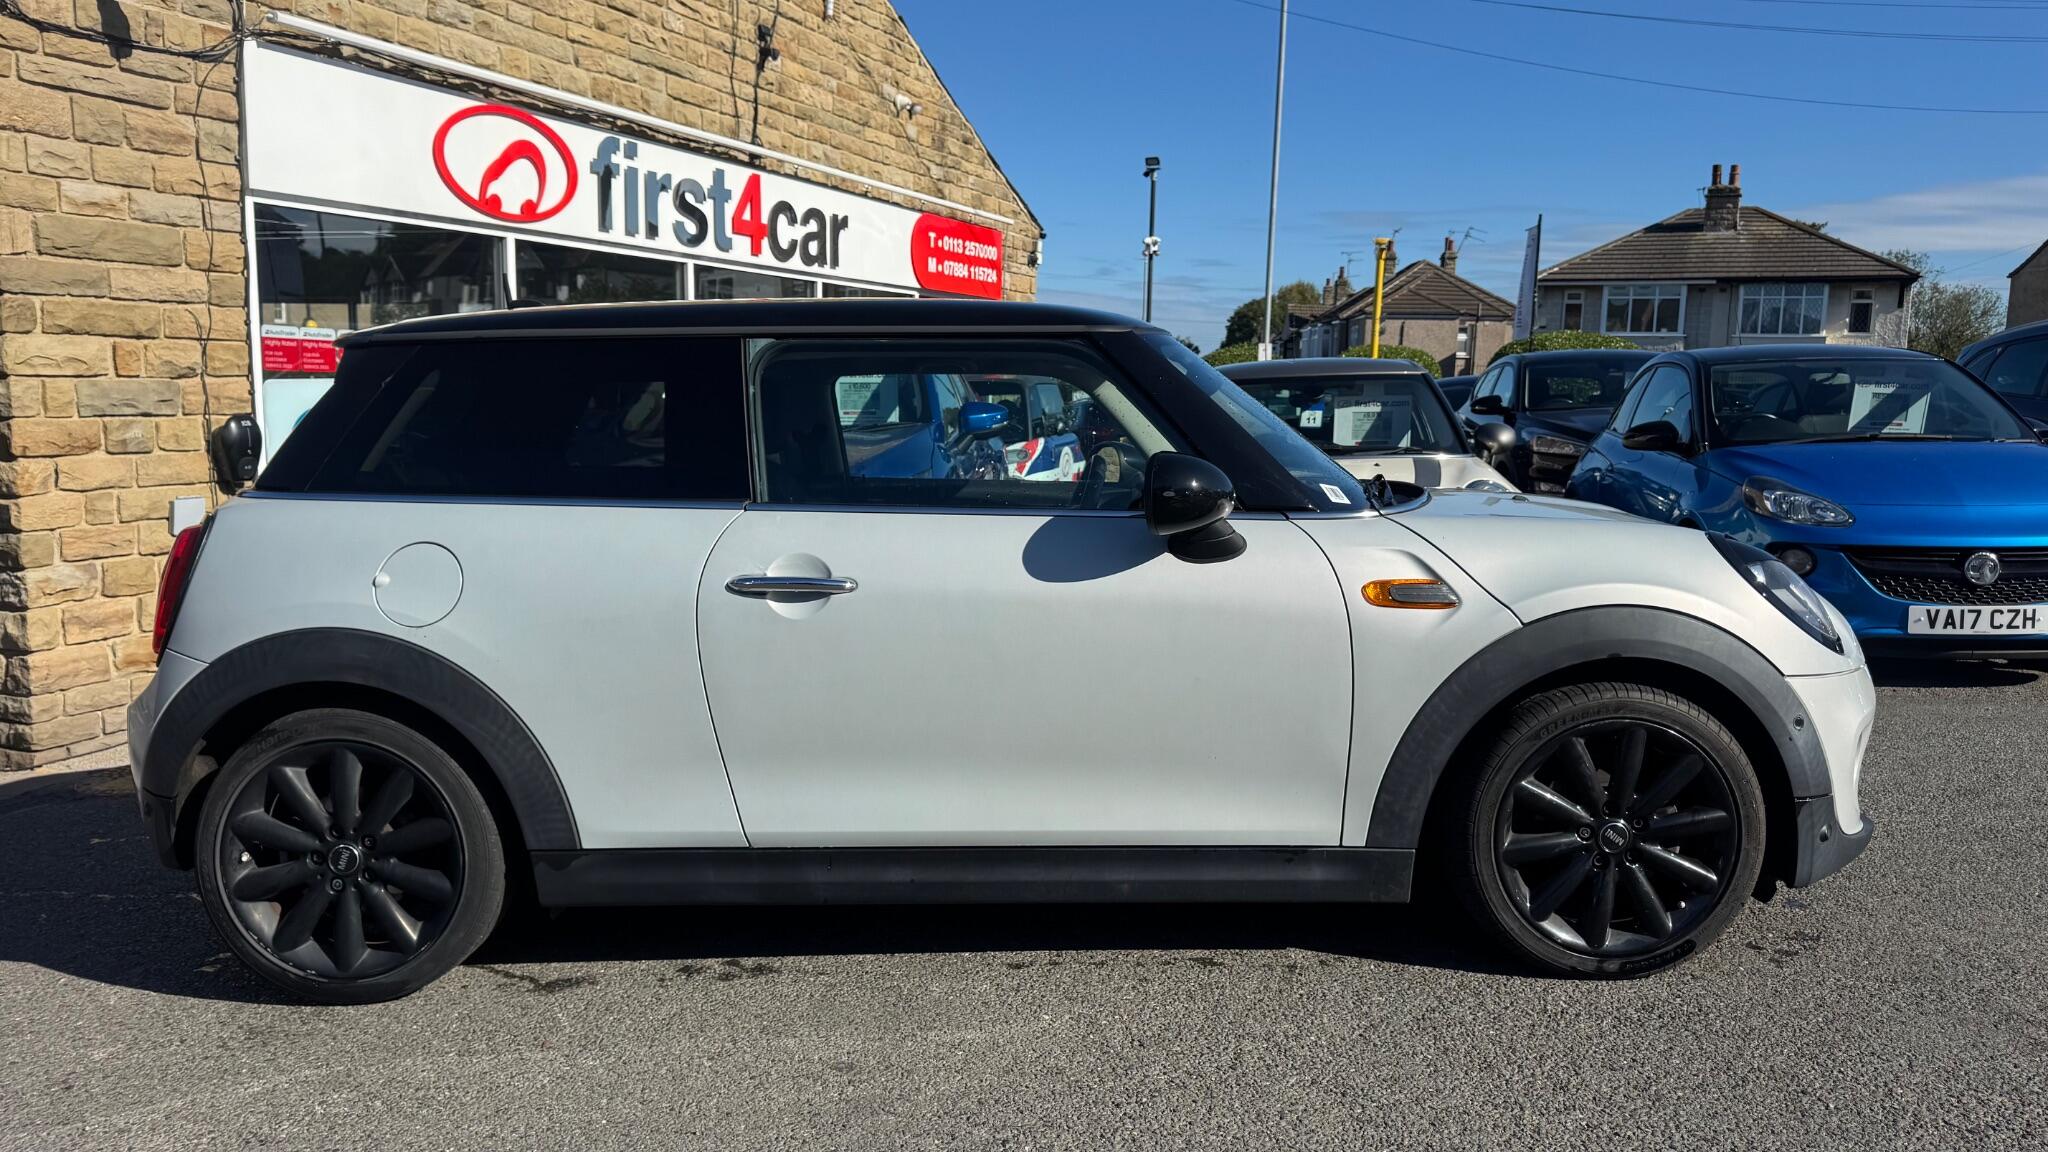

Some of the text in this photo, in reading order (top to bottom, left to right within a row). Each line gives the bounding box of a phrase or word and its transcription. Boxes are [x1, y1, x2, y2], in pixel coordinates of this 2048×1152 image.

[590, 136, 849, 269] first4car
[969, 264, 998, 283] 115724
[1926, 609, 2037, 630] VA17 CZH
[1604, 828, 1625, 847] MINI
[337, 848, 352, 870] MINI
